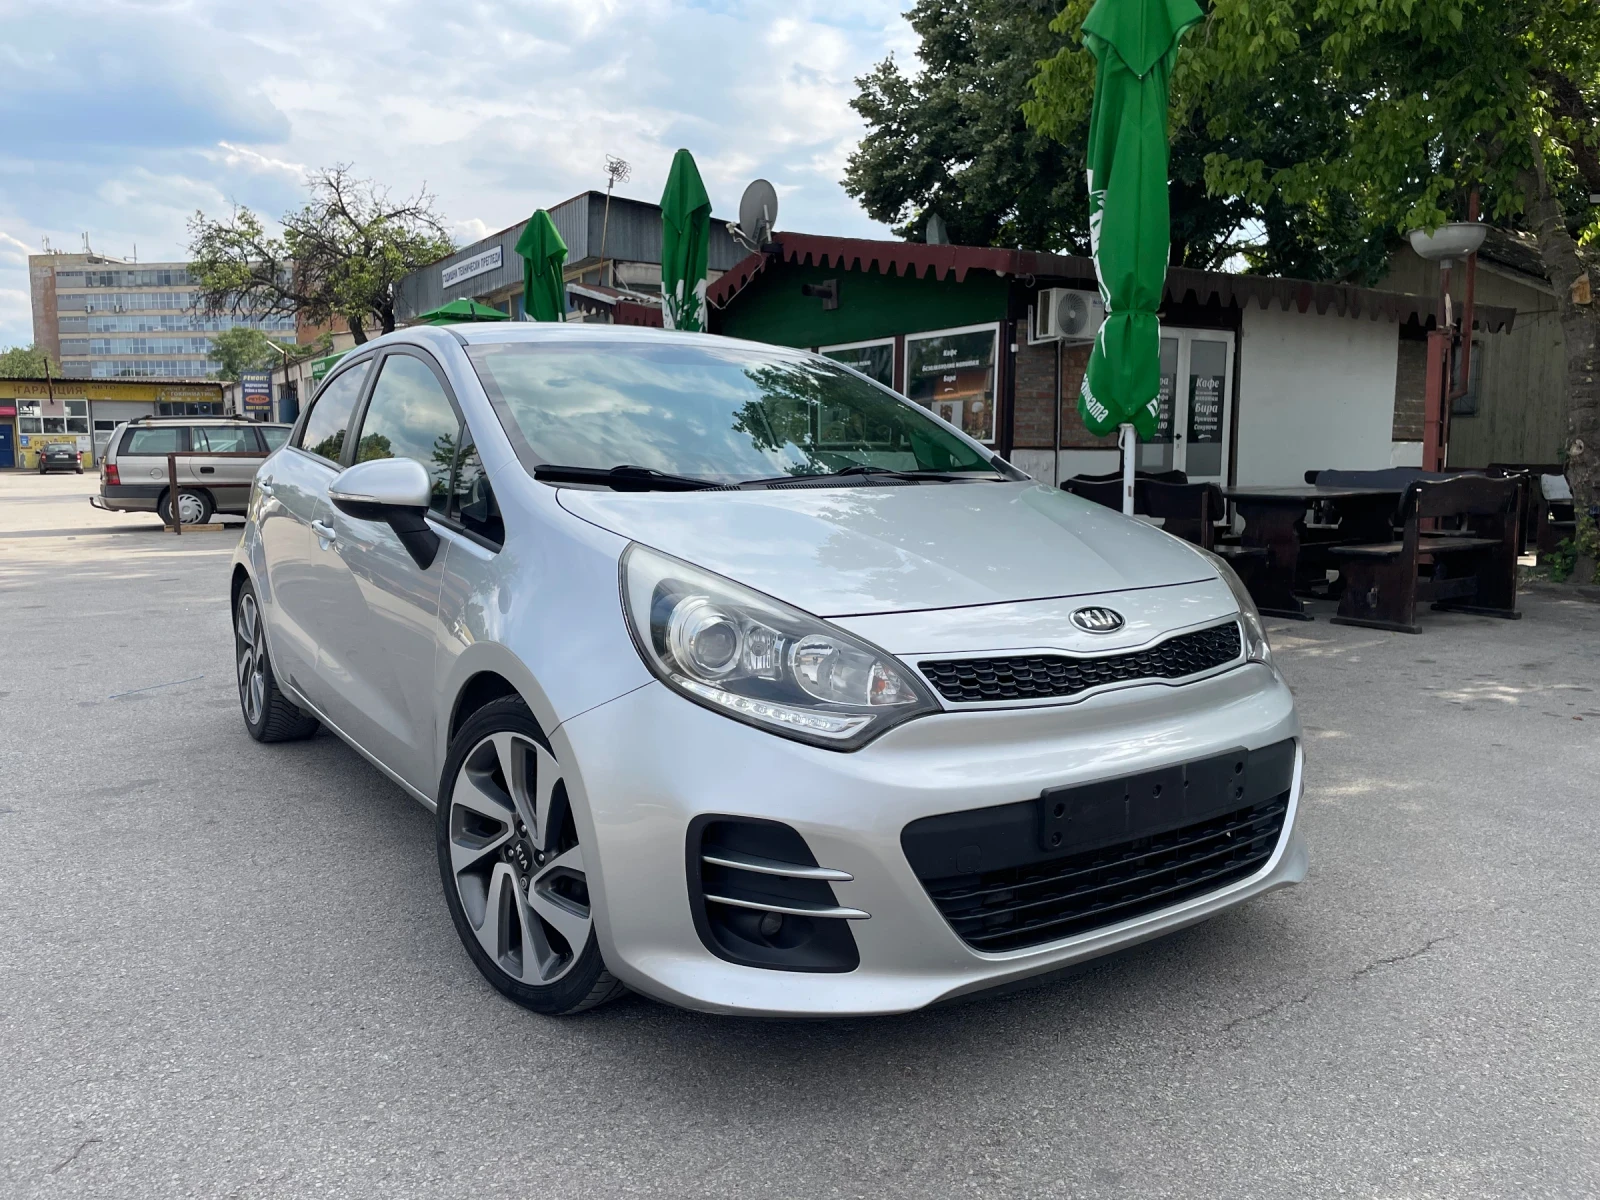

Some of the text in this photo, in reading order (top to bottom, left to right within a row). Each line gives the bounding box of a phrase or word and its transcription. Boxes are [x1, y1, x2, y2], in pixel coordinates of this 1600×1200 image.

[458, 260, 480, 276] ТЕХНИЧЕСКИ
[481, 251, 501, 268] ПРЕГЛЕДИ
[1196, 377, 1219, 390] Кафе
[1195, 402, 1218, 415] Бира
[1074, 609, 1121, 628] KIA
[516, 844, 528, 870] KIA
